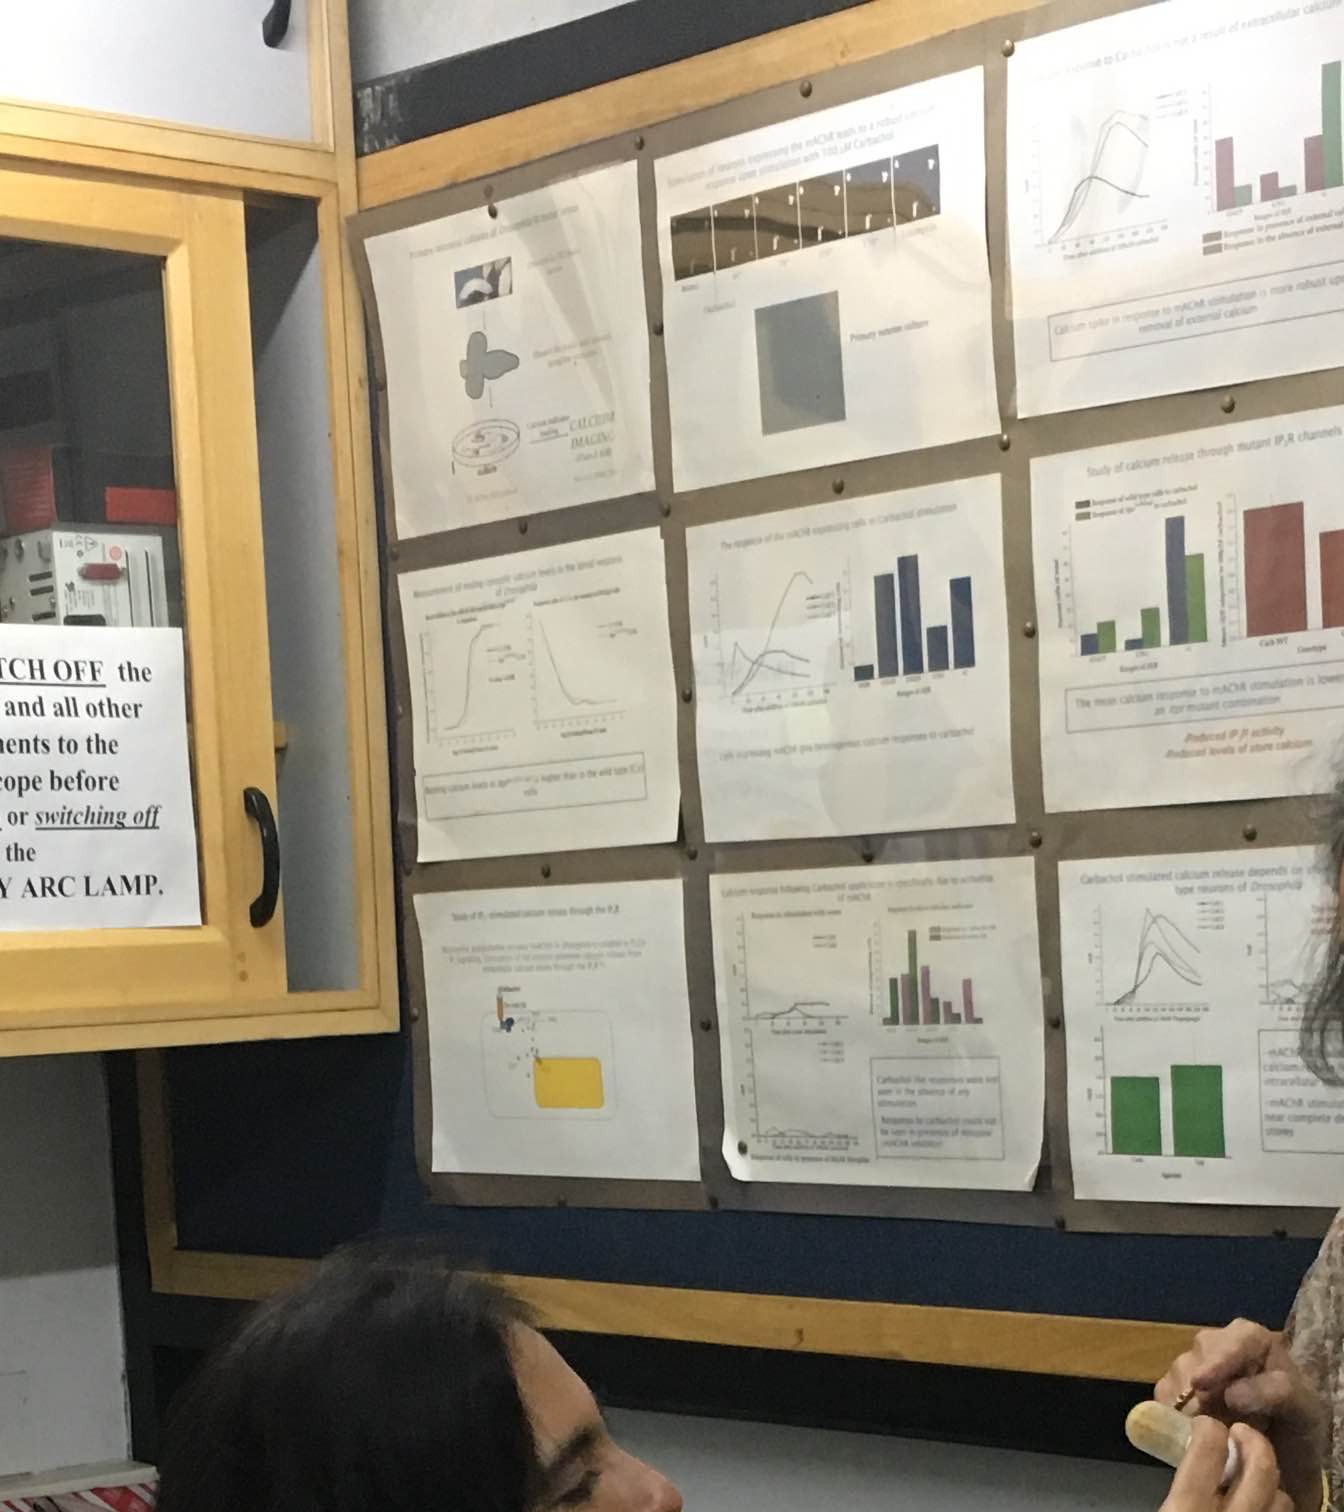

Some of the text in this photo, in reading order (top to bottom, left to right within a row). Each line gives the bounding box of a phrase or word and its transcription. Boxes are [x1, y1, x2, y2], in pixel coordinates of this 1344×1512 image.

[53, 660, 105, 683] OFF
[118, 661, 153, 683] the
[4, 697, 47, 719] and
[53, 697, 78, 719] all
[85, 697, 143, 719] other
[57, 736, 78, 755] to
[86, 734, 119, 756] the
[50, 770, 120, 792] before
[7, 810, 29, 828] or
[35, 805, 126, 831] switching
[133, 804, 162, 831] off
[6, 843, 36, 863] the
[22, 876, 76, 899] ARC
[84, 874, 164, 898] LAMP.
